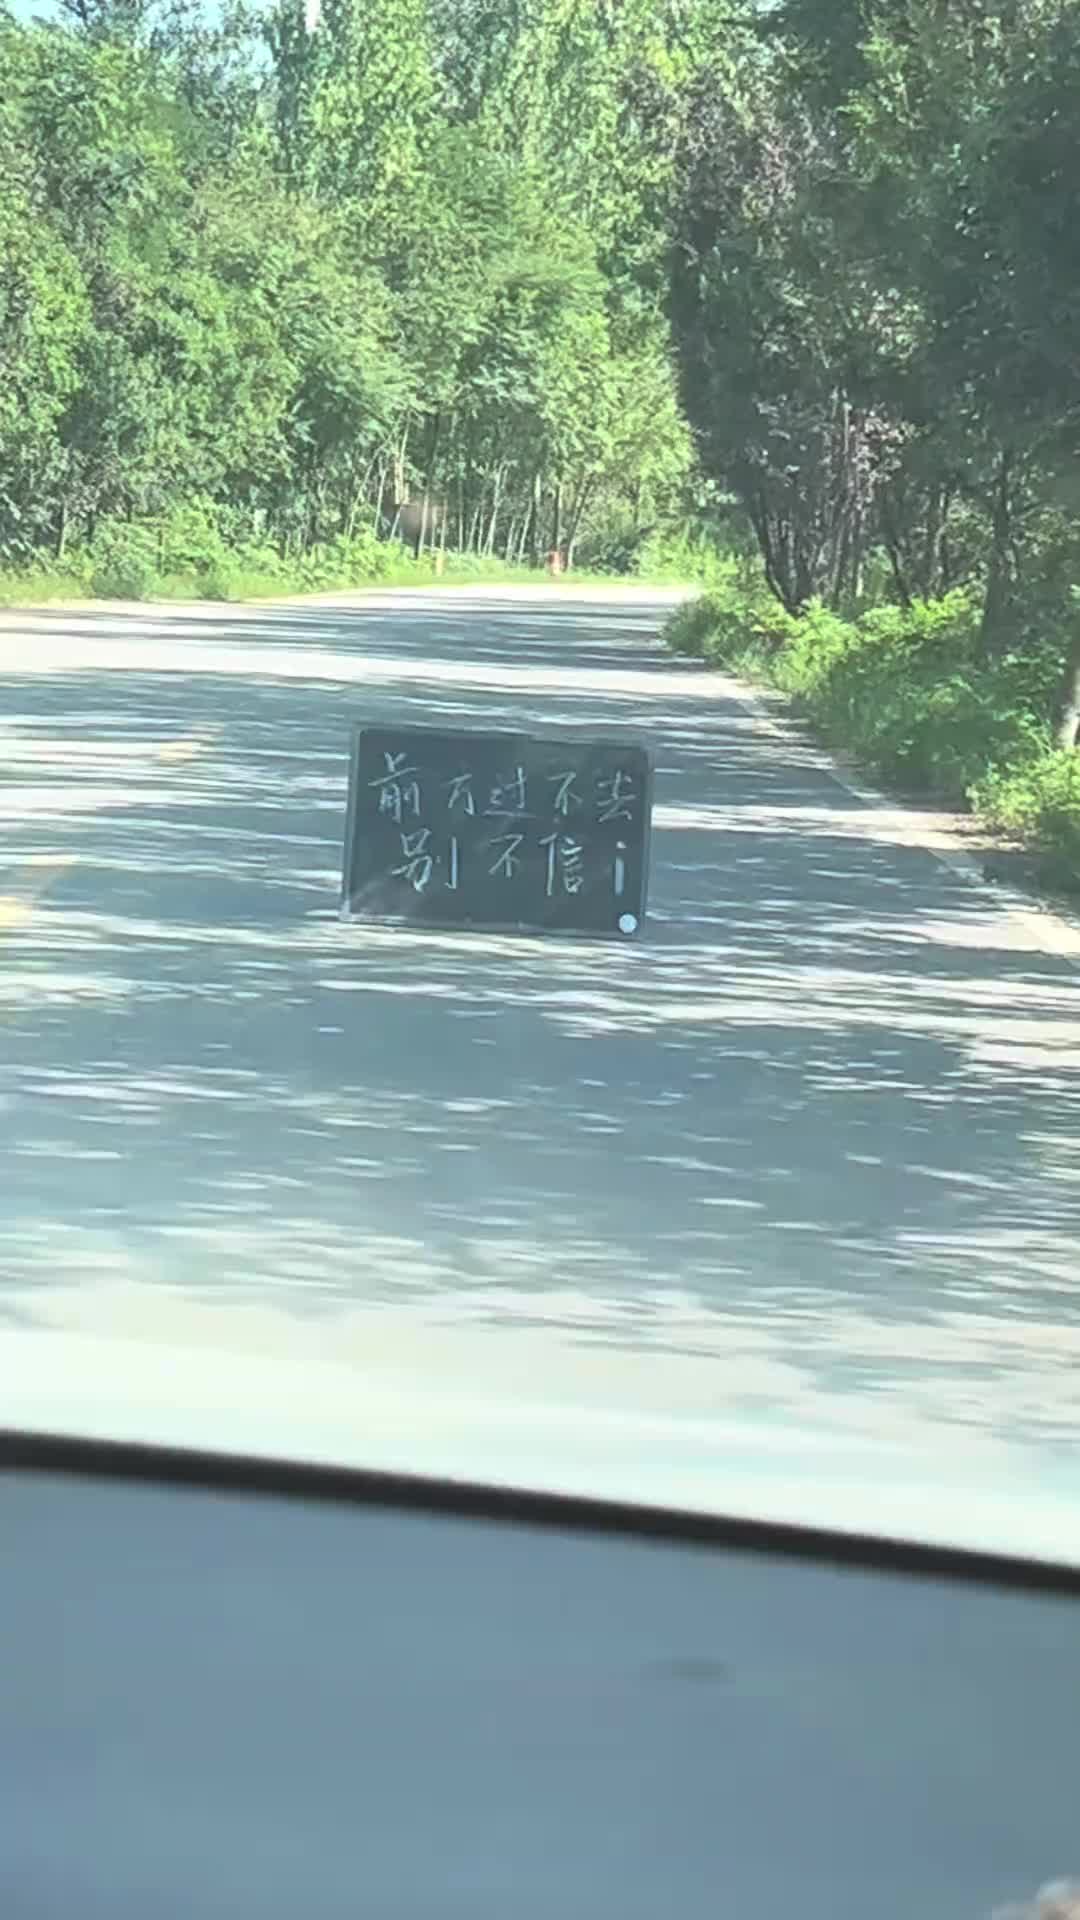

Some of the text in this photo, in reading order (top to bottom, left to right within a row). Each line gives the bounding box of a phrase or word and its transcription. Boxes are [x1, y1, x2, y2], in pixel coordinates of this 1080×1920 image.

[368, 751, 636, 823] 前方过不去
